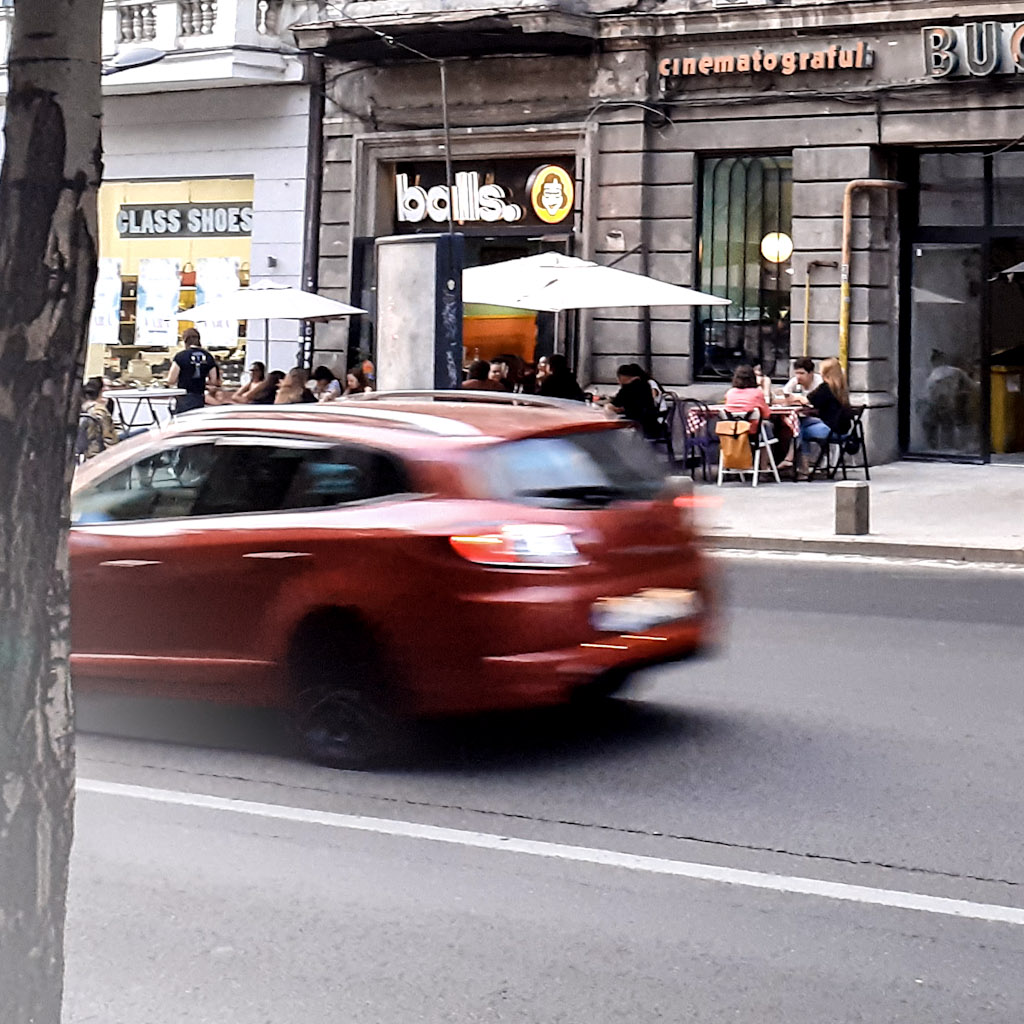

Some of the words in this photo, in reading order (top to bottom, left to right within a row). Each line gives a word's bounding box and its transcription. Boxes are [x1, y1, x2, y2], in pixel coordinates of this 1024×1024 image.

[658, 41, 866, 76] cinematograful
[395, 171, 523, 223] balls.
[116, 209, 182, 234] CLASS
[187, 207, 253, 233] SHOES
